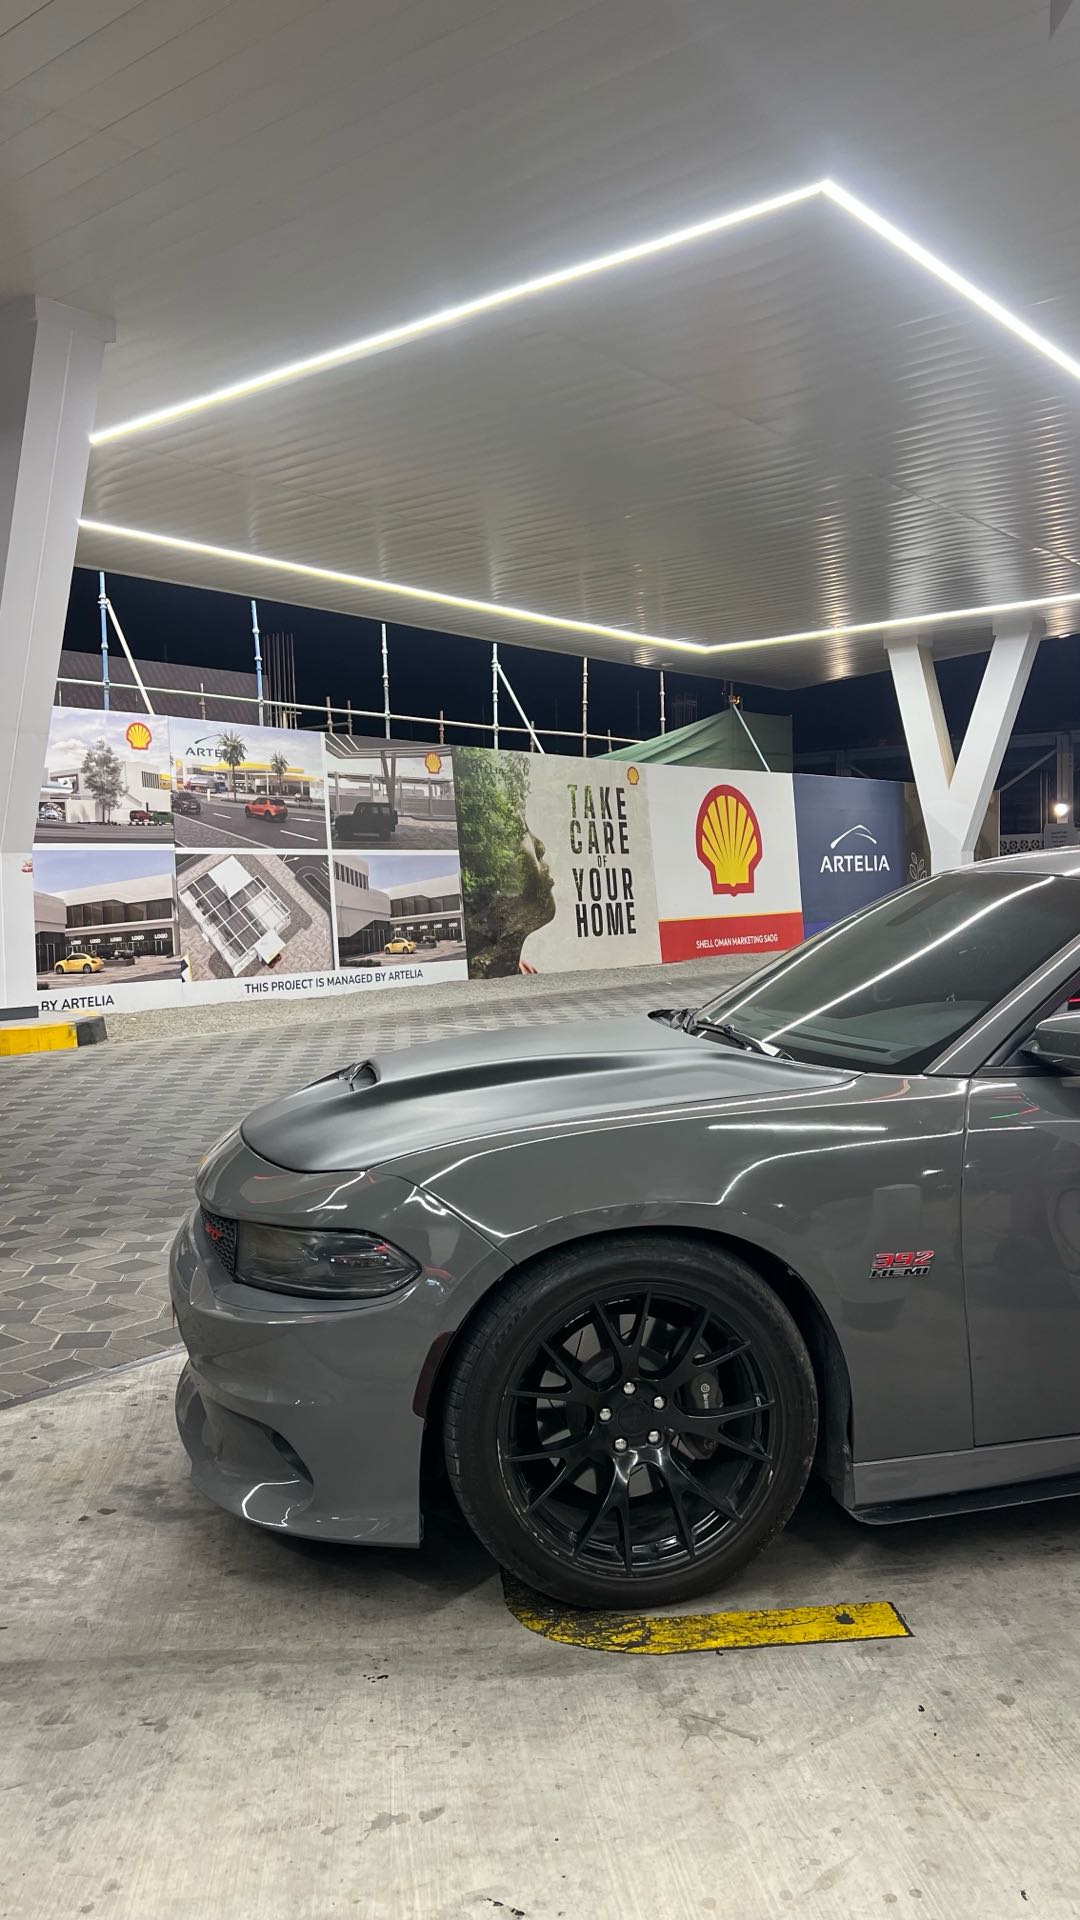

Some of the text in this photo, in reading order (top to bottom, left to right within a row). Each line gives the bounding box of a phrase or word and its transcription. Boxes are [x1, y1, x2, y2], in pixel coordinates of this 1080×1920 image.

[567, 784, 627, 820] TAKE
[569, 819, 630, 854] CARE
[597, 855, 607, 868] OF
[820, 855, 890, 873] ARTELIA
[572, 867, 634, 901] YOUR
[575, 902, 637, 938] HOME
[696, 933, 778, 949] SHELL OMAN MARKETING SAOG
[244, 969, 423, 993] THIS PROJECT IS MANAGED BY ARTELIA
[41, 995, 115, 1010] BY ARTELIA
[872, 1250, 935, 1268] 392
[869, 1266, 931, 1278] HEMI
